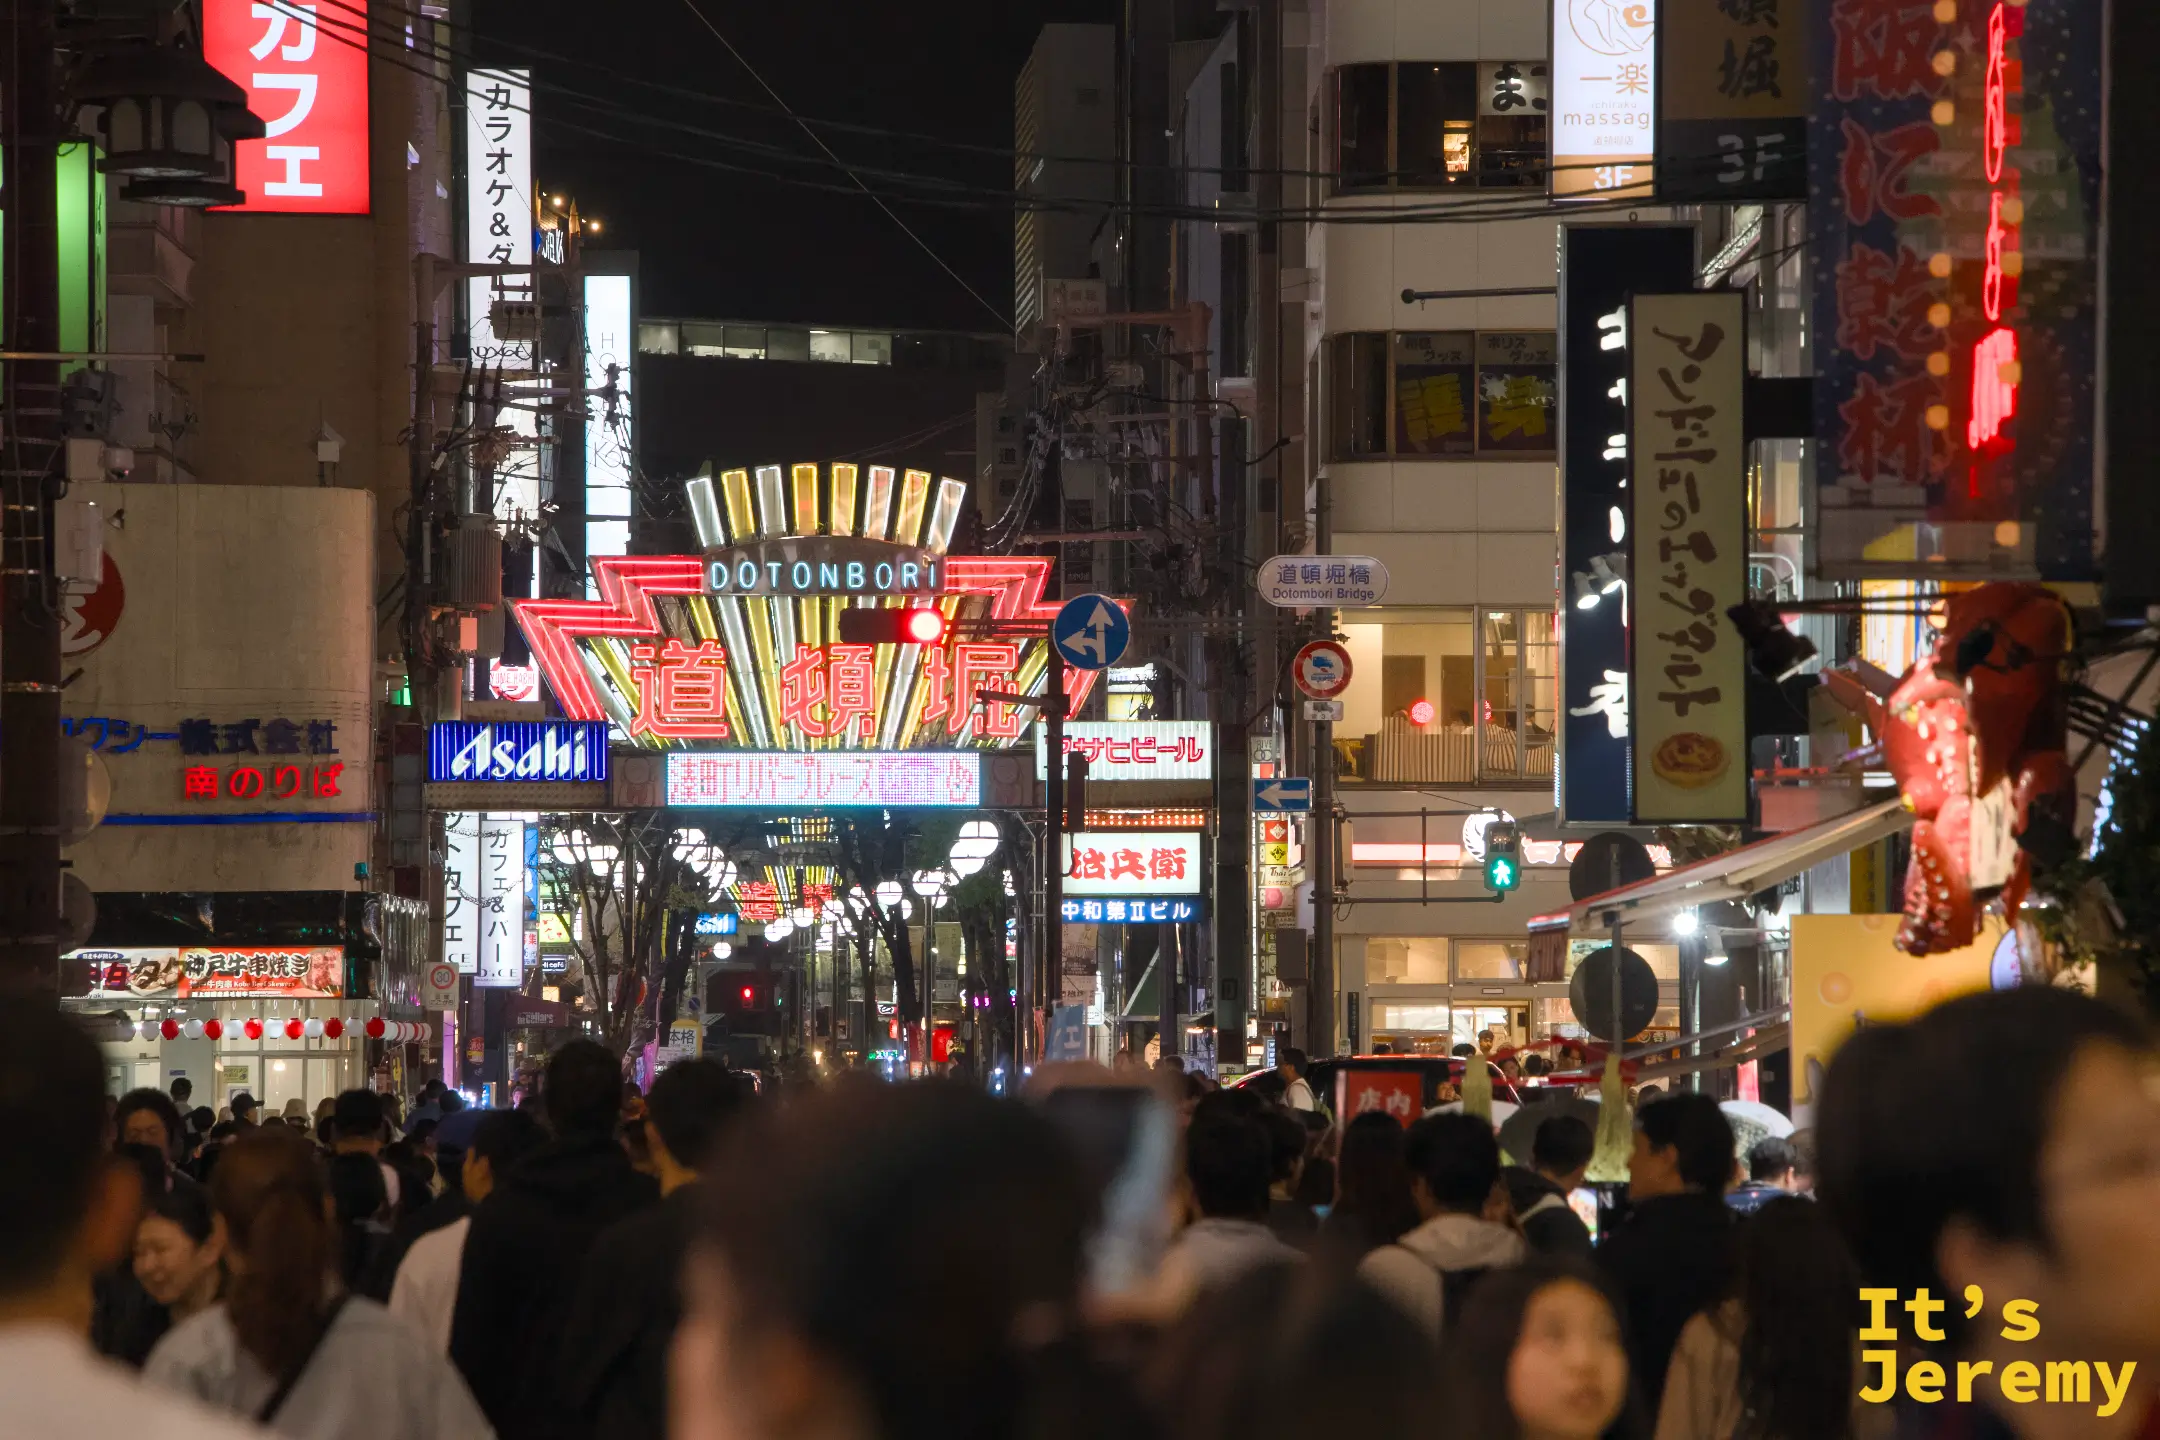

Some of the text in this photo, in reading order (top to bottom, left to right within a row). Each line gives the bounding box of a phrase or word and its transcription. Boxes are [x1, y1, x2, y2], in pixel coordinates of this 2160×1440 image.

[1580, 63, 1649, 95] 一楽
[1591, 101, 1637, 109] ichiraku
[1563, 112, 1650, 129] massag
[1717, 134, 1785, 183] 3F
[1594, 166, 1633, 190] 3F
[1652, 322, 1724, 717] アンドリューのエッグタルト
[710, 561, 937, 589] DOTONBORI
[1277, 564, 1370, 585] 道頓堀橋
[1272, 588, 1374, 601] Dotombori Bridge
[630, 638, 1019, 738] 道頓堀
[451, 723, 587, 778] Asahi
[185, 762, 345, 799] 南のりば
[488, 829, 509, 962] カフェ&バー
[184, 953, 311, 978] 神戸牛串焼き
[436, 971, 450, 984] 30
